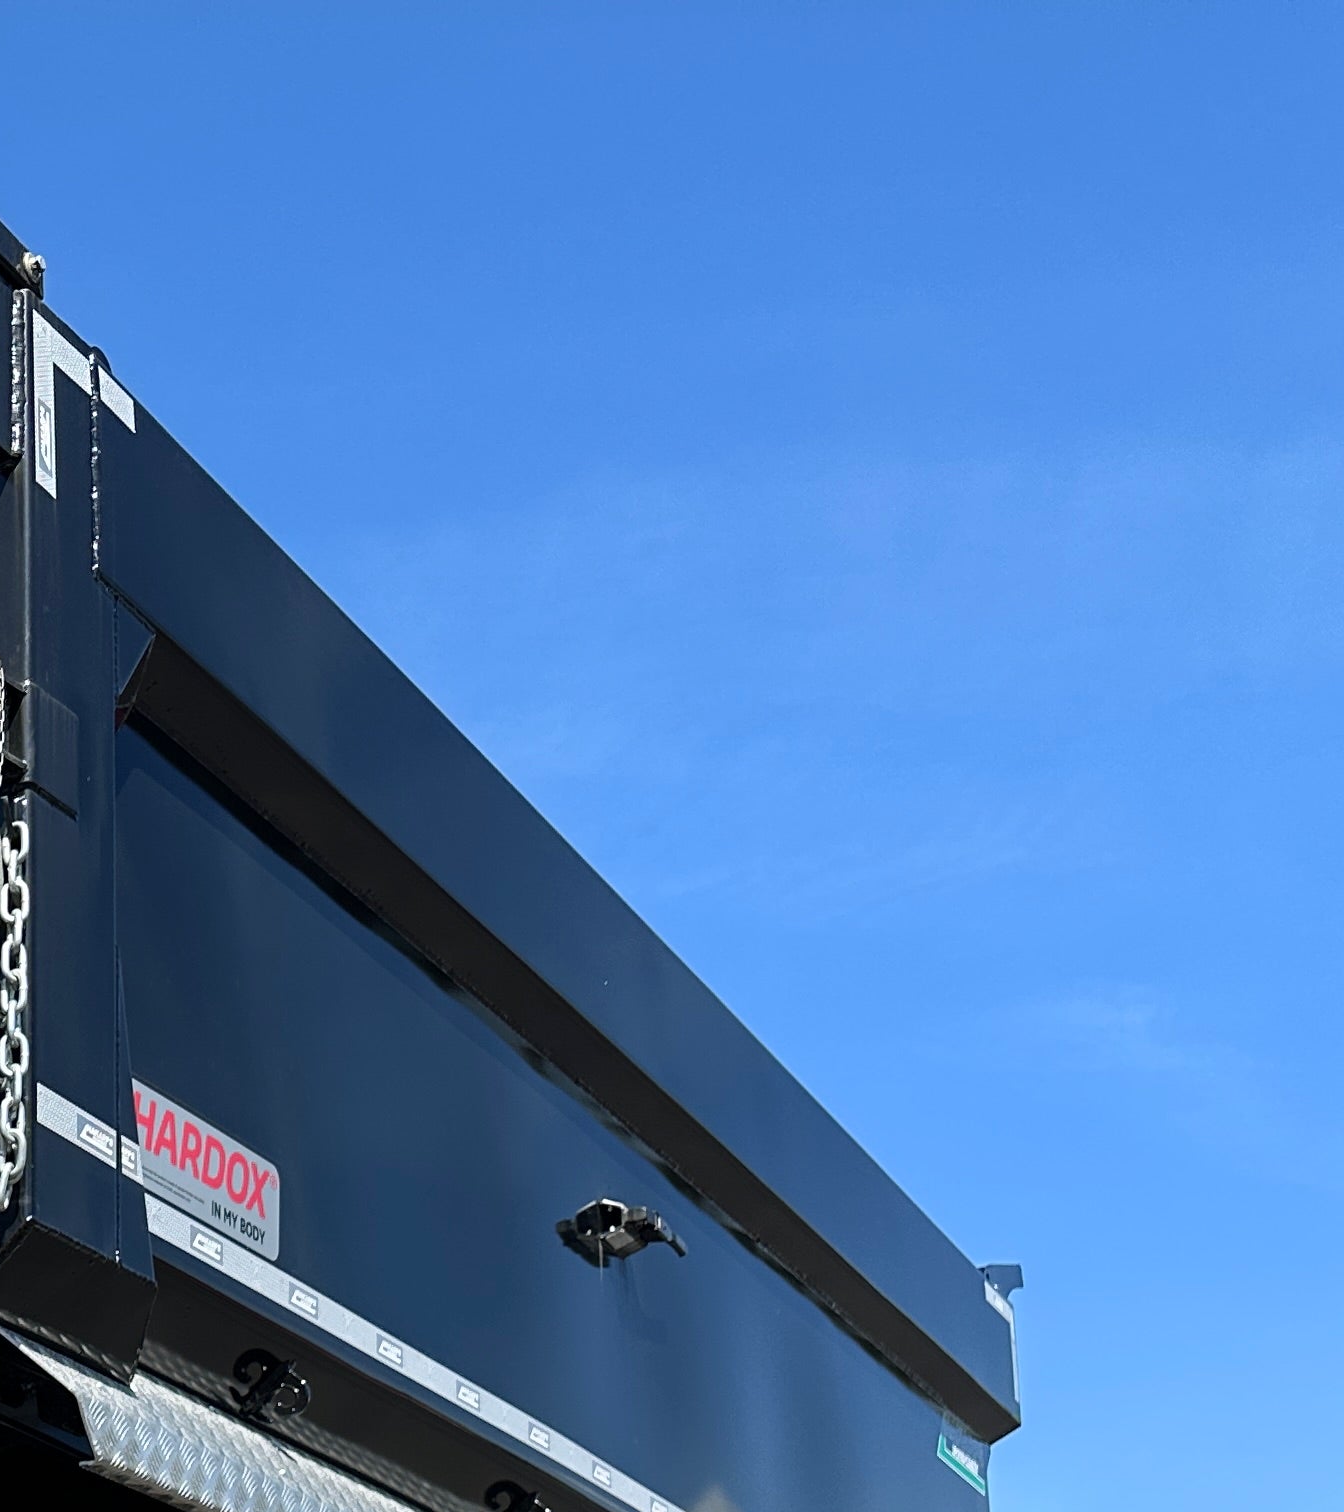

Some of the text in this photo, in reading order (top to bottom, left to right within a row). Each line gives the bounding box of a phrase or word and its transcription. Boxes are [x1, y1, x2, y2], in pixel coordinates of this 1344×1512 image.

[133, 1091, 270, 1219] HARDOX
[211, 1200, 221, 1219] IN
[223, 1208, 238, 1228] MY
[240, 1218, 266, 1244] BODY
